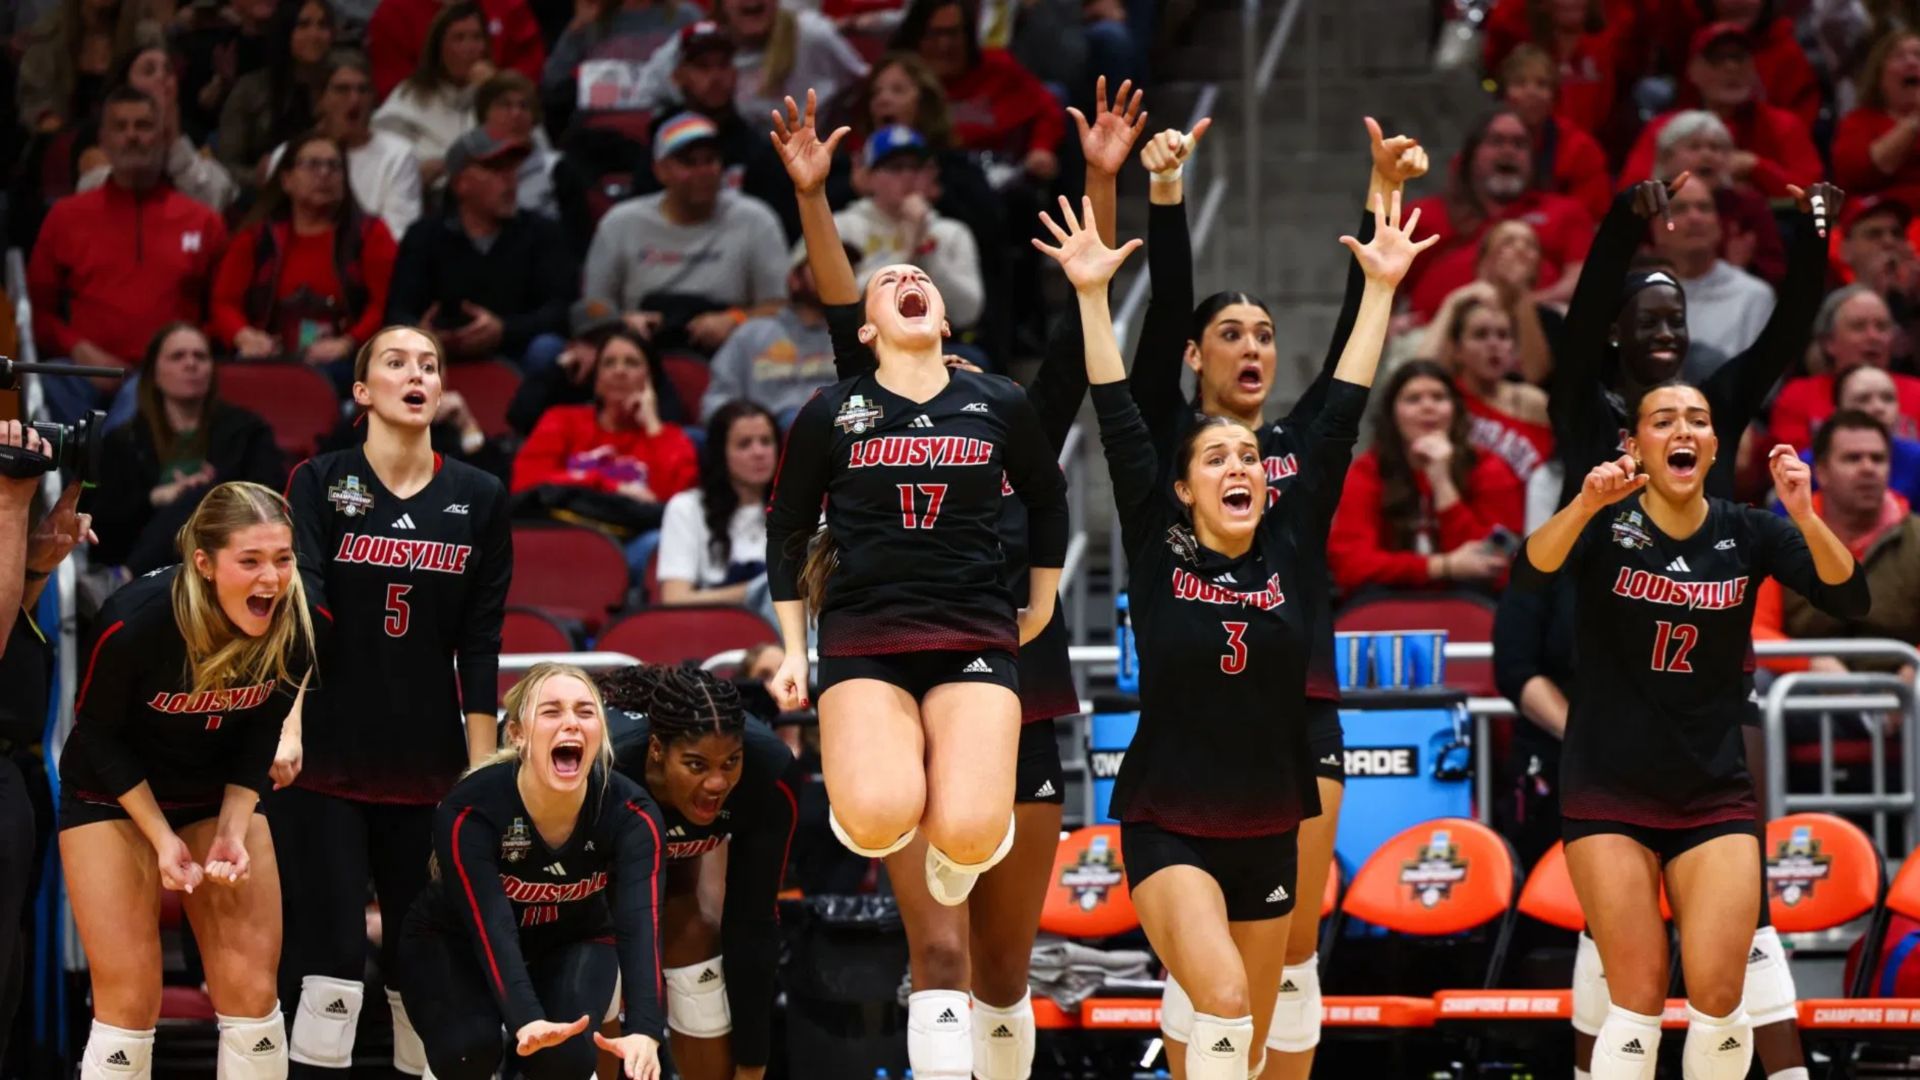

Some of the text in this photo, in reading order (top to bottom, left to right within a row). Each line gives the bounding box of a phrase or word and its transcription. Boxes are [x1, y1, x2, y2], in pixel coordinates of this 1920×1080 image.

[960, 402, 989, 413] ACC
[848, 436, 994, 470] LOUISVILLE
[442, 504, 470, 515] ACC
[896, 483, 949, 529] 17
[334, 532, 472, 574] LOUISVILLE
[1612, 566, 1750, 612] LOUISVILLE
[384, 583, 413, 638] 5
[1220, 621, 1249, 675] 3
[1651, 620, 1699, 673] 12
[147, 679, 276, 714] LOUISVILL
[106, 1057, 130, 1066] adidas
[252, 1044, 275, 1052] adidas
[1621, 1046, 1645, 1054] adidas
